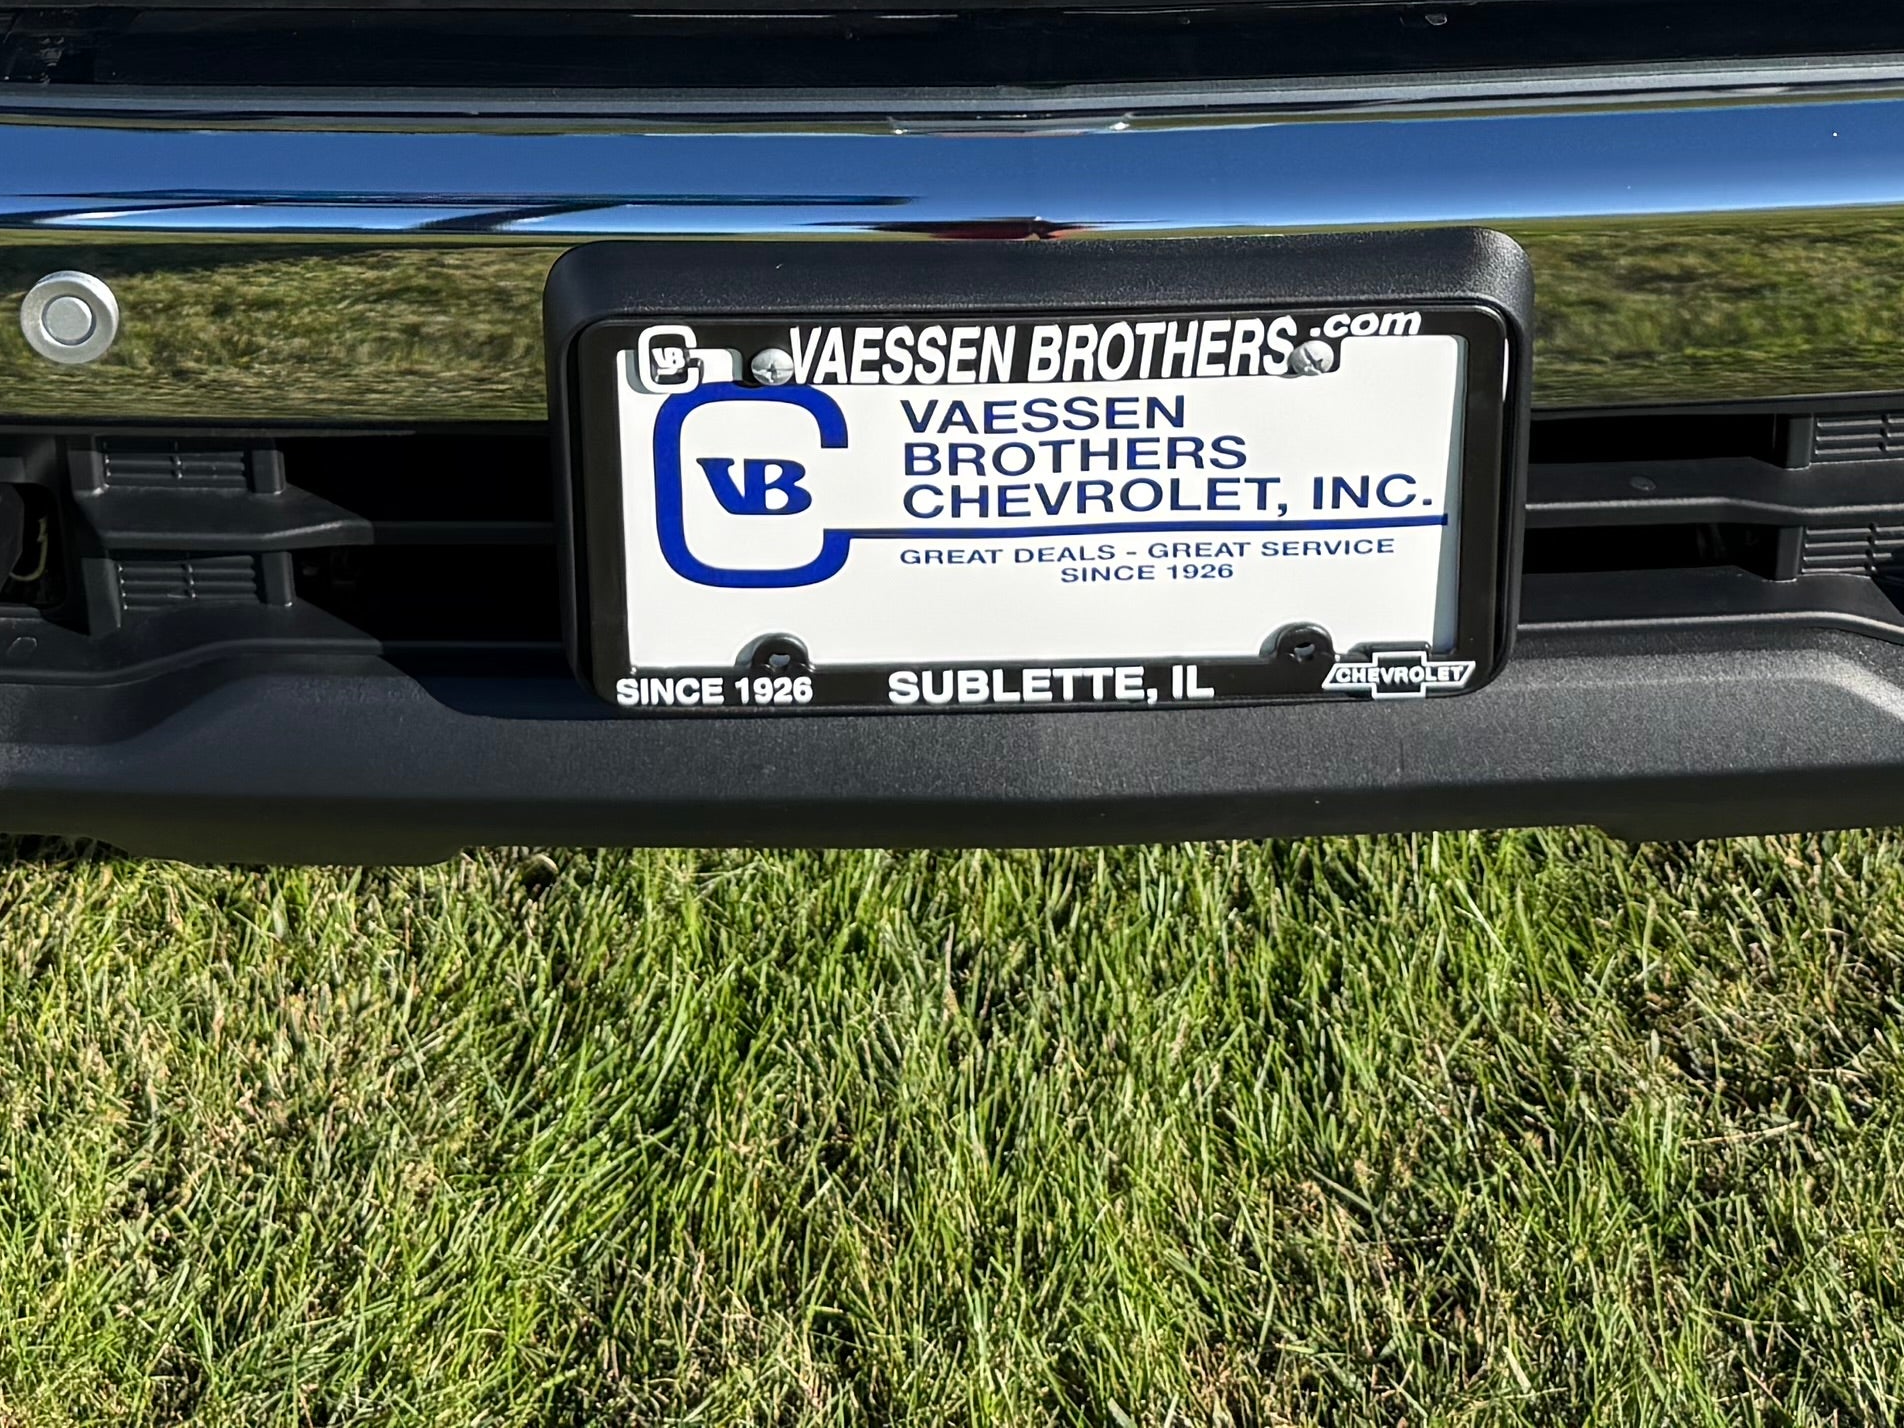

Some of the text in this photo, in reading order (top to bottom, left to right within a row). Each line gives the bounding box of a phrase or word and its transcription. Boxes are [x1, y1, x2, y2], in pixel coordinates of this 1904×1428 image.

[790, 325, 1017, 384] VAESSEN
[1027, 314, 1298, 383] BROTHERS
[899, 394, 1186, 434] VAESSEN
[903, 434, 1248, 477] BROTHERS
[902, 473, 1433, 518] CHEVROLET, INC.
[900, 548, 1004, 565] GREAT
[1014, 544, 1116, 564] DEALS
[1148, 542, 1252, 559] GREAT
[1261, 538, 1395, 557] SERVICE
[1060, 563, 1234, 583] SINCE 1926
[616, 676, 814, 706] SINCE 1926
[888, 664, 1215, 705] SUBLETTE, IL
[1335, 665, 1464, 685] CHEVROLET
